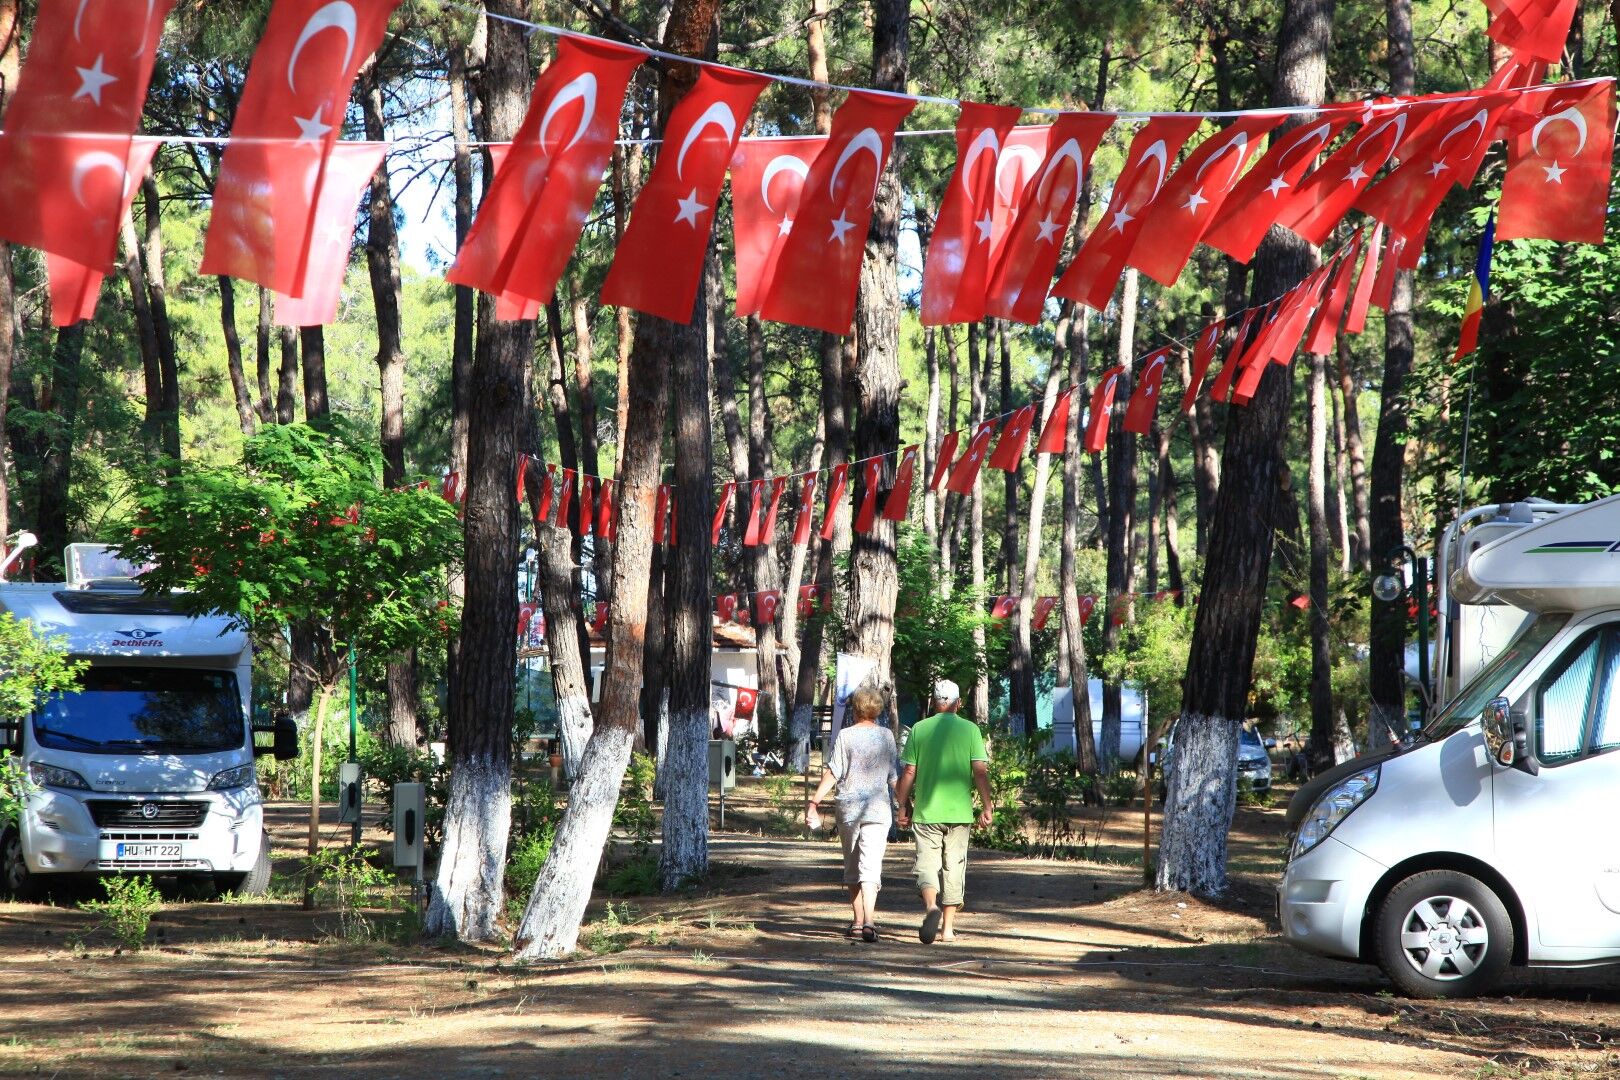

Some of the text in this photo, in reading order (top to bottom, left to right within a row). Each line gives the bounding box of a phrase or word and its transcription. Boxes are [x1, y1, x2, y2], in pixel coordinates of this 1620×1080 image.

[112, 639, 163, 647] Dethleffs
[124, 845, 180, 856] HU HT 222
